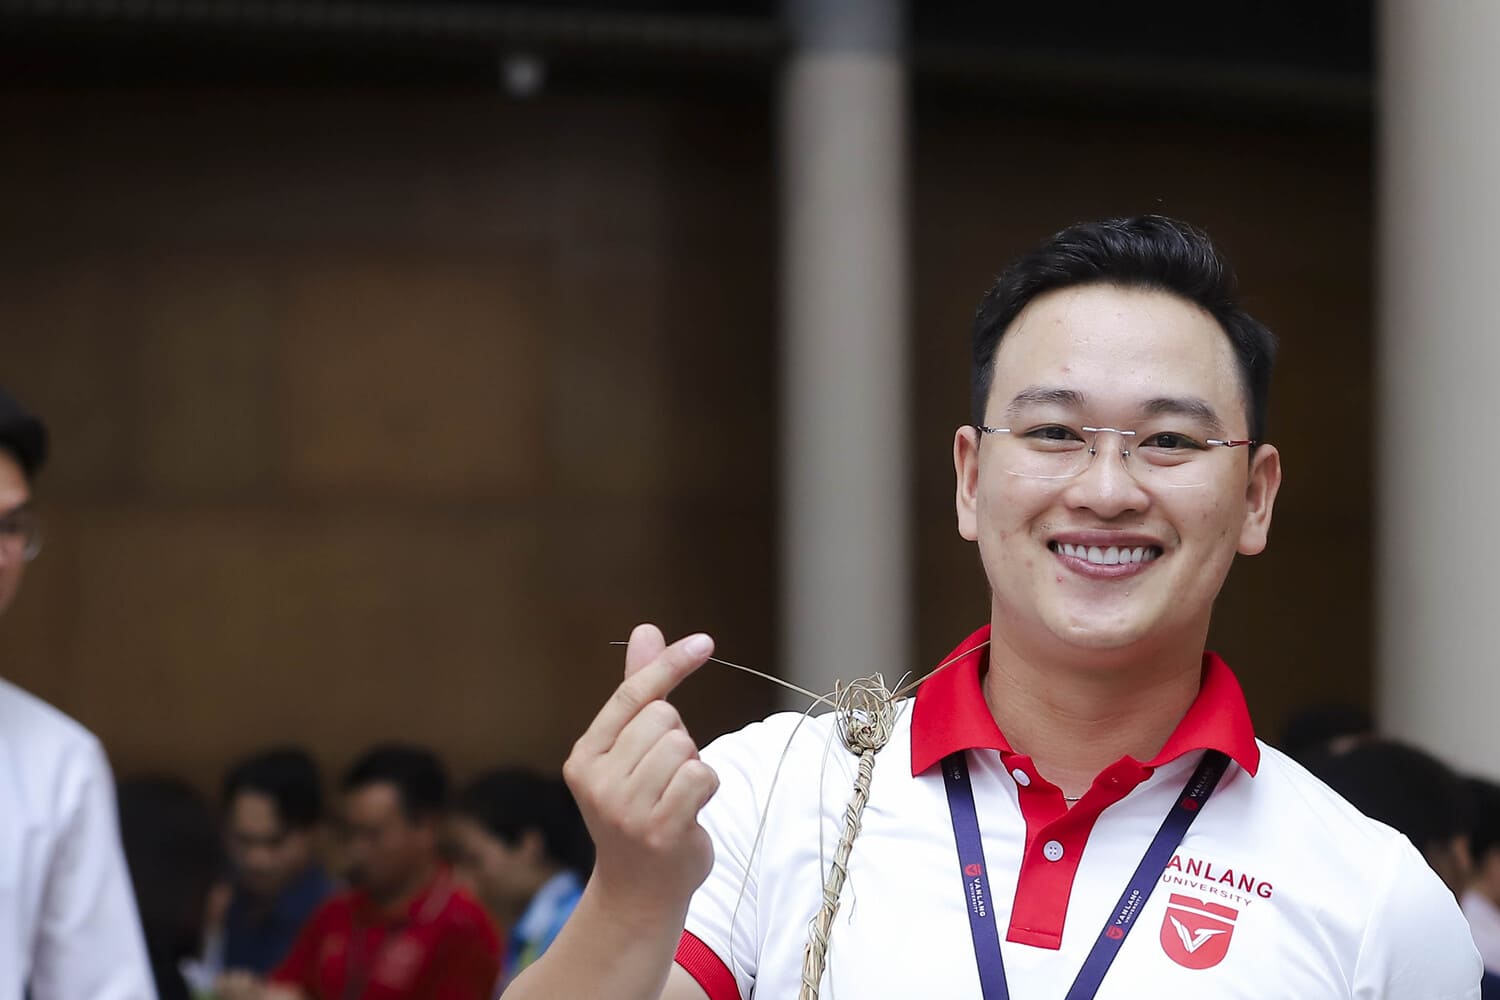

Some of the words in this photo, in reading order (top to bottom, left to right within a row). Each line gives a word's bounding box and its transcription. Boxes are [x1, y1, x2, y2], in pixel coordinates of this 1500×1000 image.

[1162, 874, 1252, 906] UNIVERSITY
[1166, 855, 1273, 898] ANLANG
[974, 878, 986, 917] VANLANG
[1115, 889, 1140, 925] VANLANG
